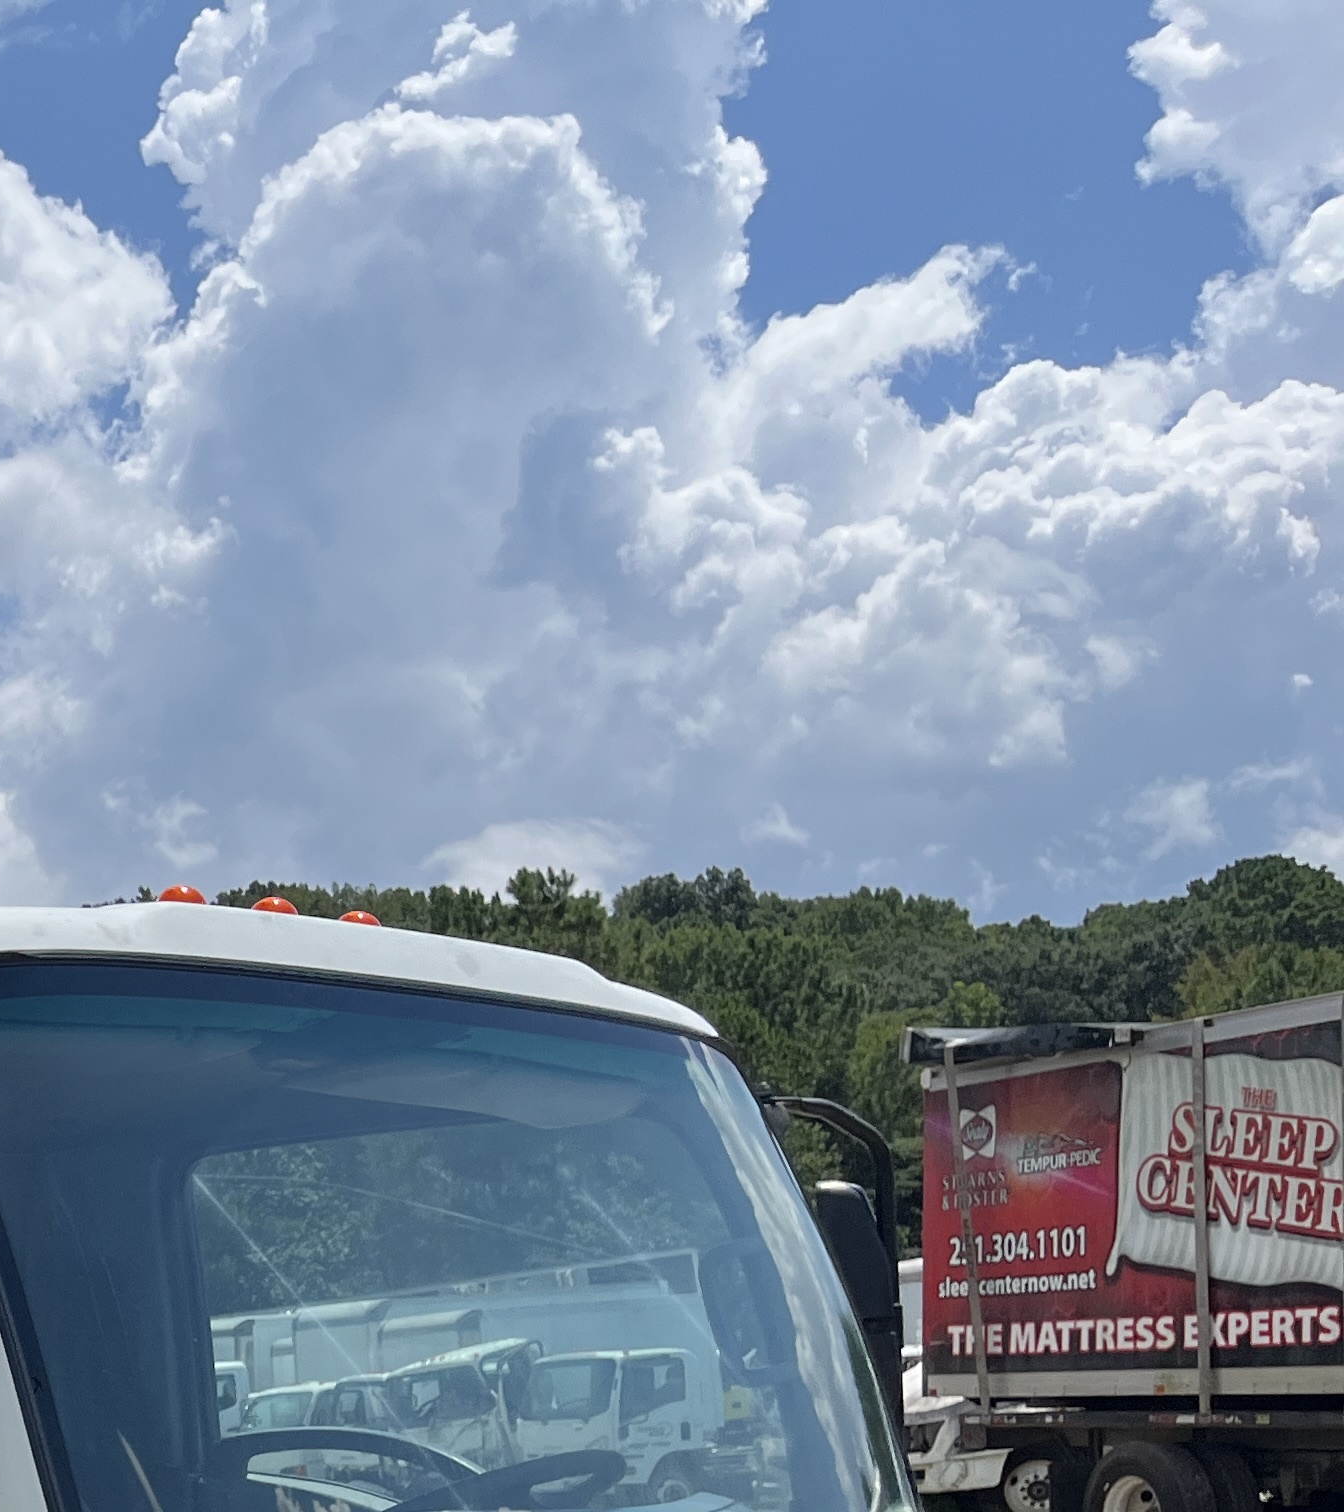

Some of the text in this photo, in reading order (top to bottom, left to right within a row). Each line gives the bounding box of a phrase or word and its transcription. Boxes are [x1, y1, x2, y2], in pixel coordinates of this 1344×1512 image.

[1242, 1086, 1277, 1109] THE
[1169, 1102, 1340, 1172] SLEEP
[942, 1171, 1006, 1191] STARNS
[1137, 1153, 1344, 1240] CENTER
[939, 1268, 1097, 1298] sleecenternow.net
[1011, 1316, 1175, 1354] MATTRESS
[1184, 1306, 1342, 1348] EXPERTS
